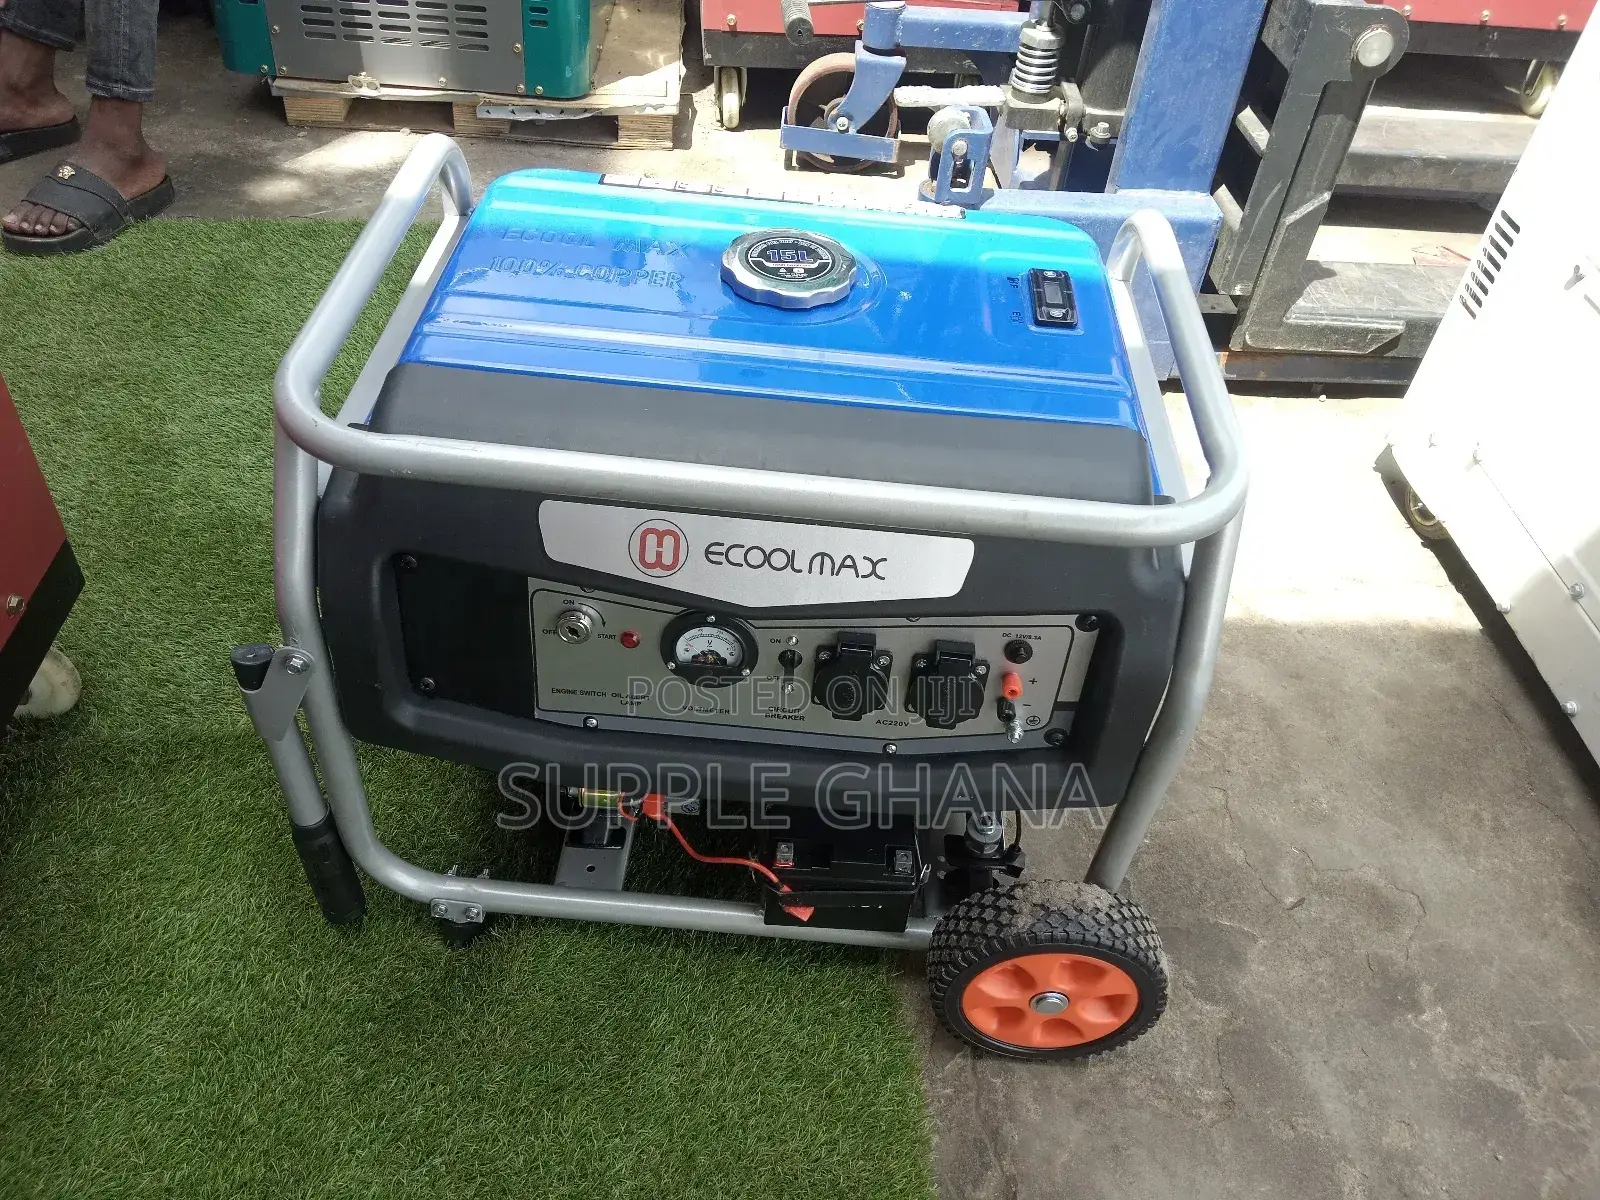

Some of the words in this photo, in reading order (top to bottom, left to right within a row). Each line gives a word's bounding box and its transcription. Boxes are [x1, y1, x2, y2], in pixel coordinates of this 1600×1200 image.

[611, 237, 692, 258] MAX
[766, 249, 814, 263] 15L
[573, 262, 686, 289] COPPER
[704, 541, 803, 574] ECOOL
[807, 551, 888, 581] MAX
[551, 687, 579, 696] ENGINE
[579, 689, 607, 698] SWITCH
[620, 699, 642, 707] LAMP
[767, 706, 801, 714] CIRCUIT
[764, 713, 806, 721] BREAKER
[875, 719, 910, 727] AC220V
